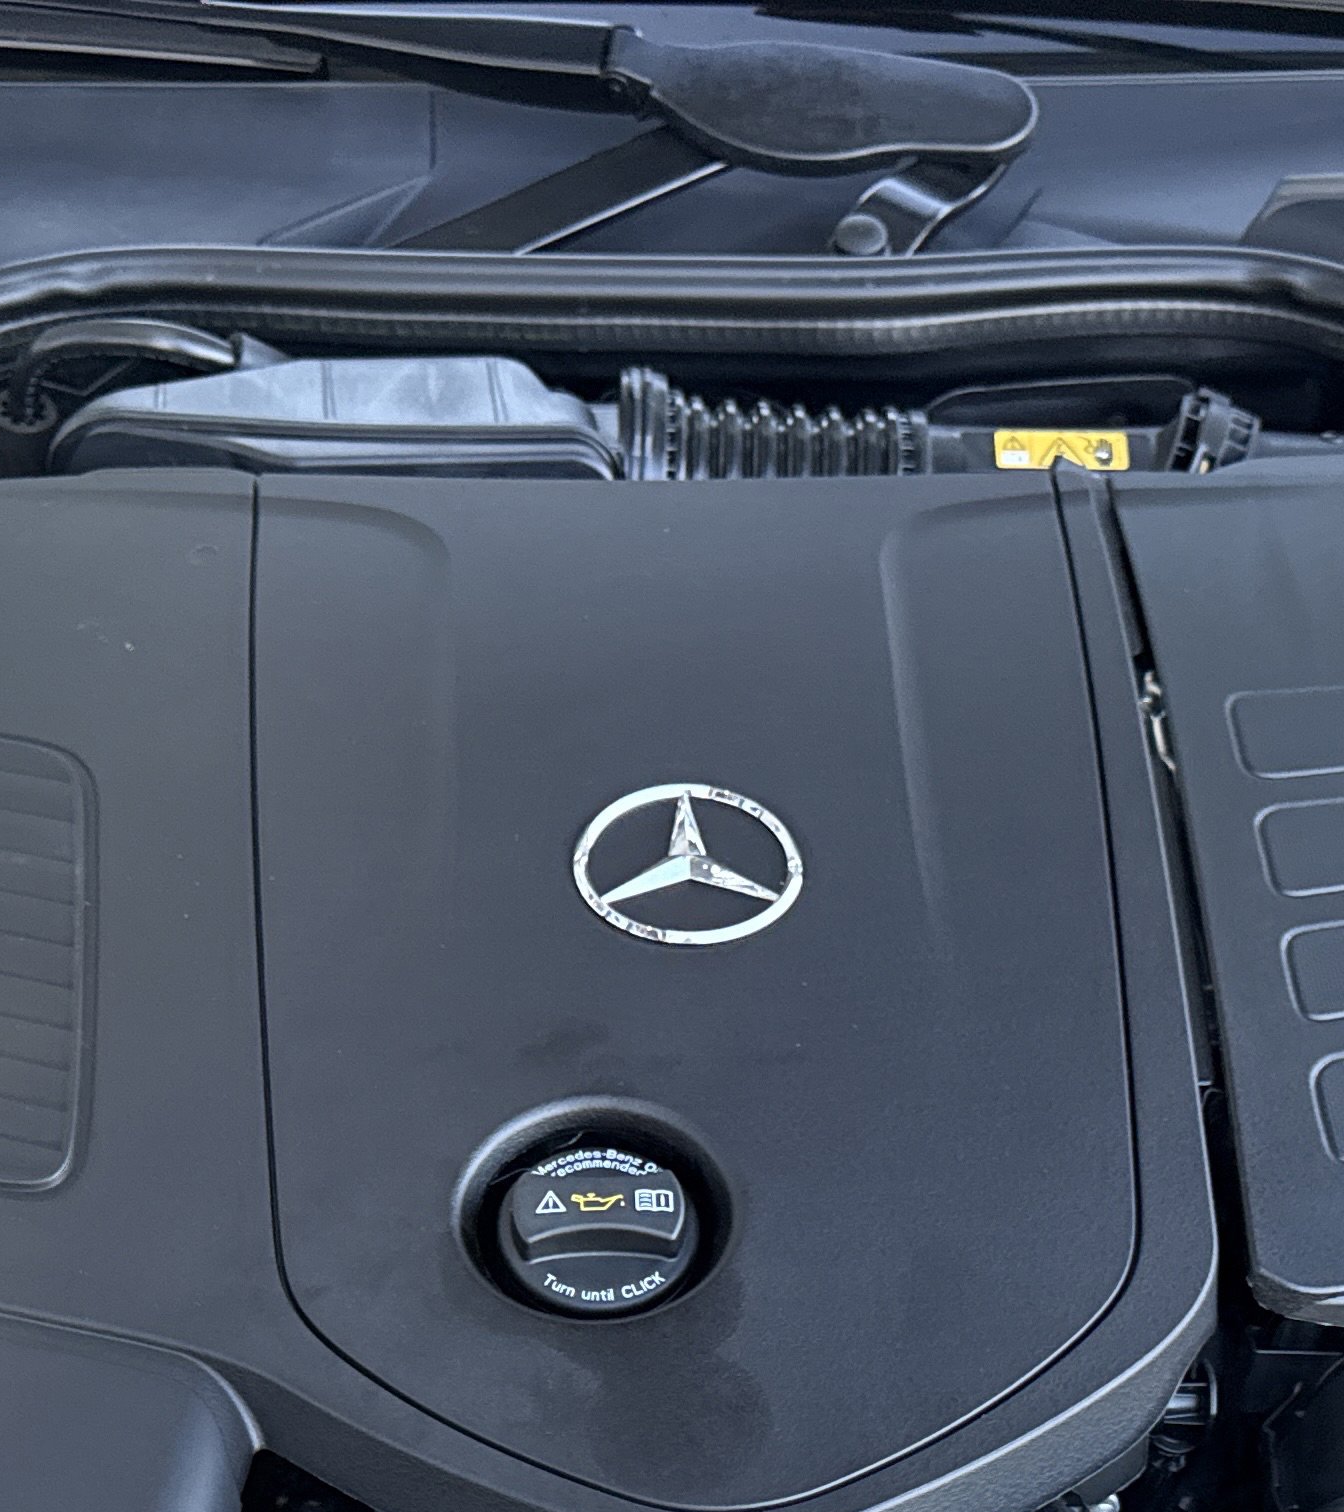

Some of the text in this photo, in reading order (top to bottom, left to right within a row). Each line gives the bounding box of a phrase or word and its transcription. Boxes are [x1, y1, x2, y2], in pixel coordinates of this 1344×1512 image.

[544, 1271, 666, 1301] Turn until CLICK
